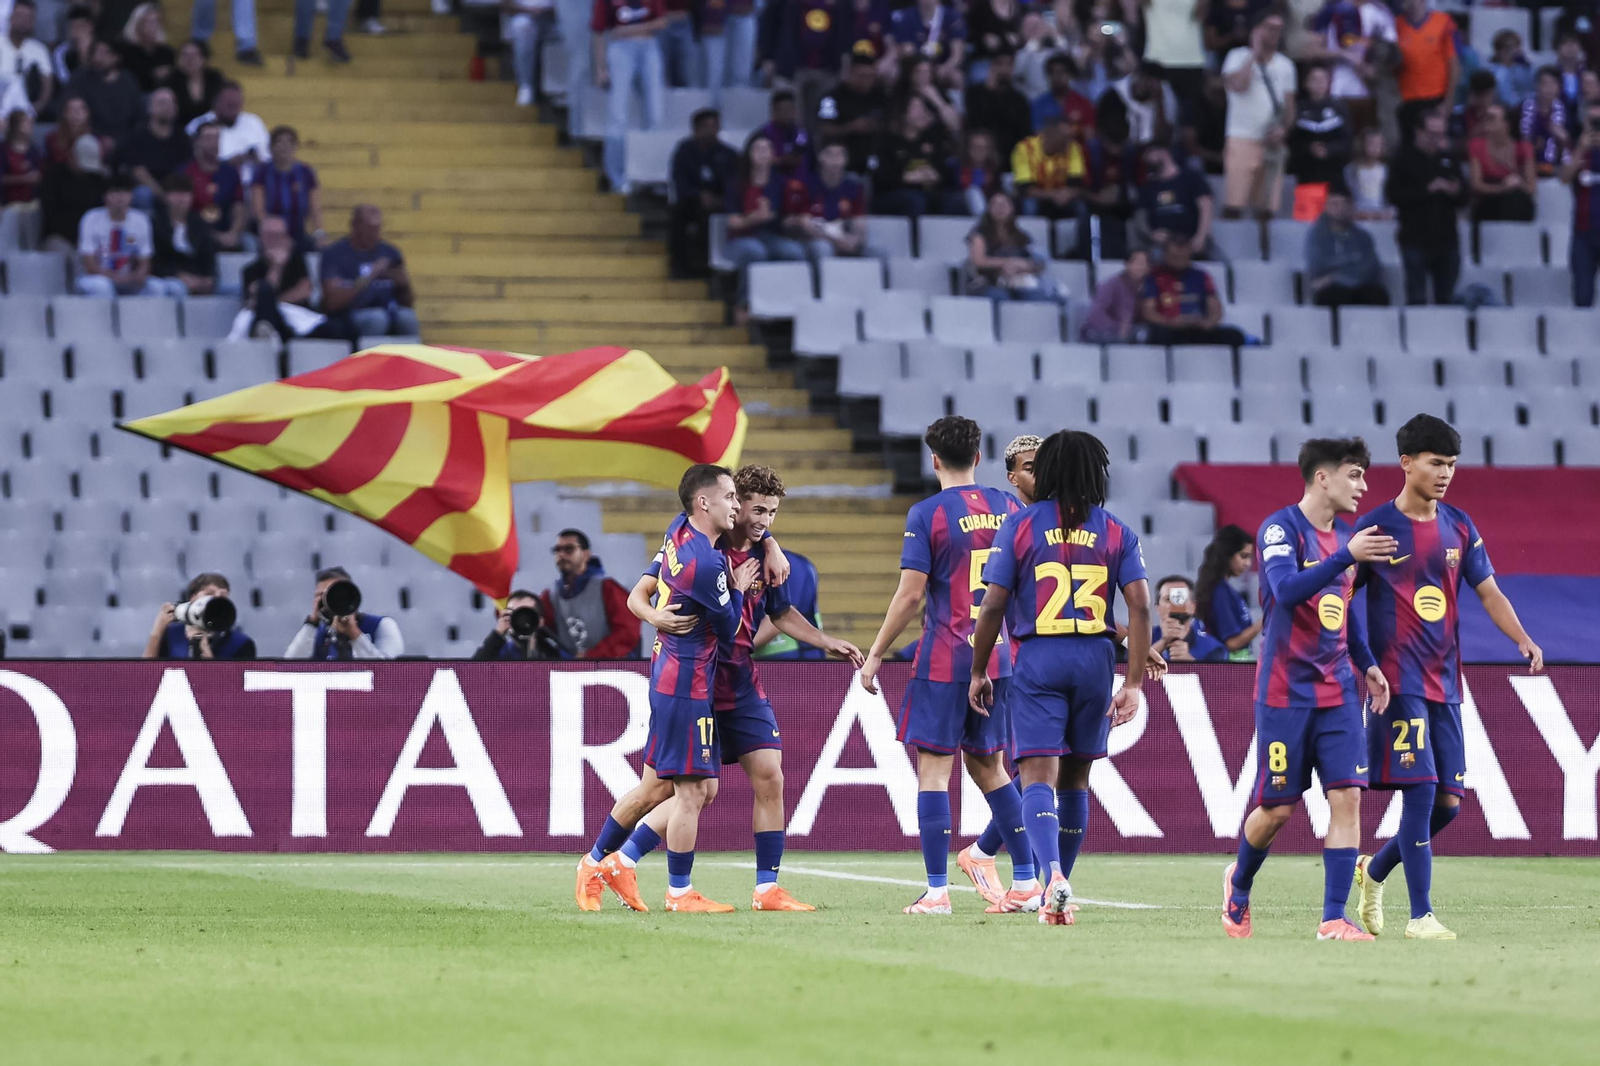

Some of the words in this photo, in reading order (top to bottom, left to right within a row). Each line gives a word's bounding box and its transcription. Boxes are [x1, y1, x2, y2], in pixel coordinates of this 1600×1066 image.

[1035, 562, 1108, 635] 23
[697, 716, 714, 746] 17
[1392, 718, 1426, 751] 27
[1268, 741, 1288, 772] 8
